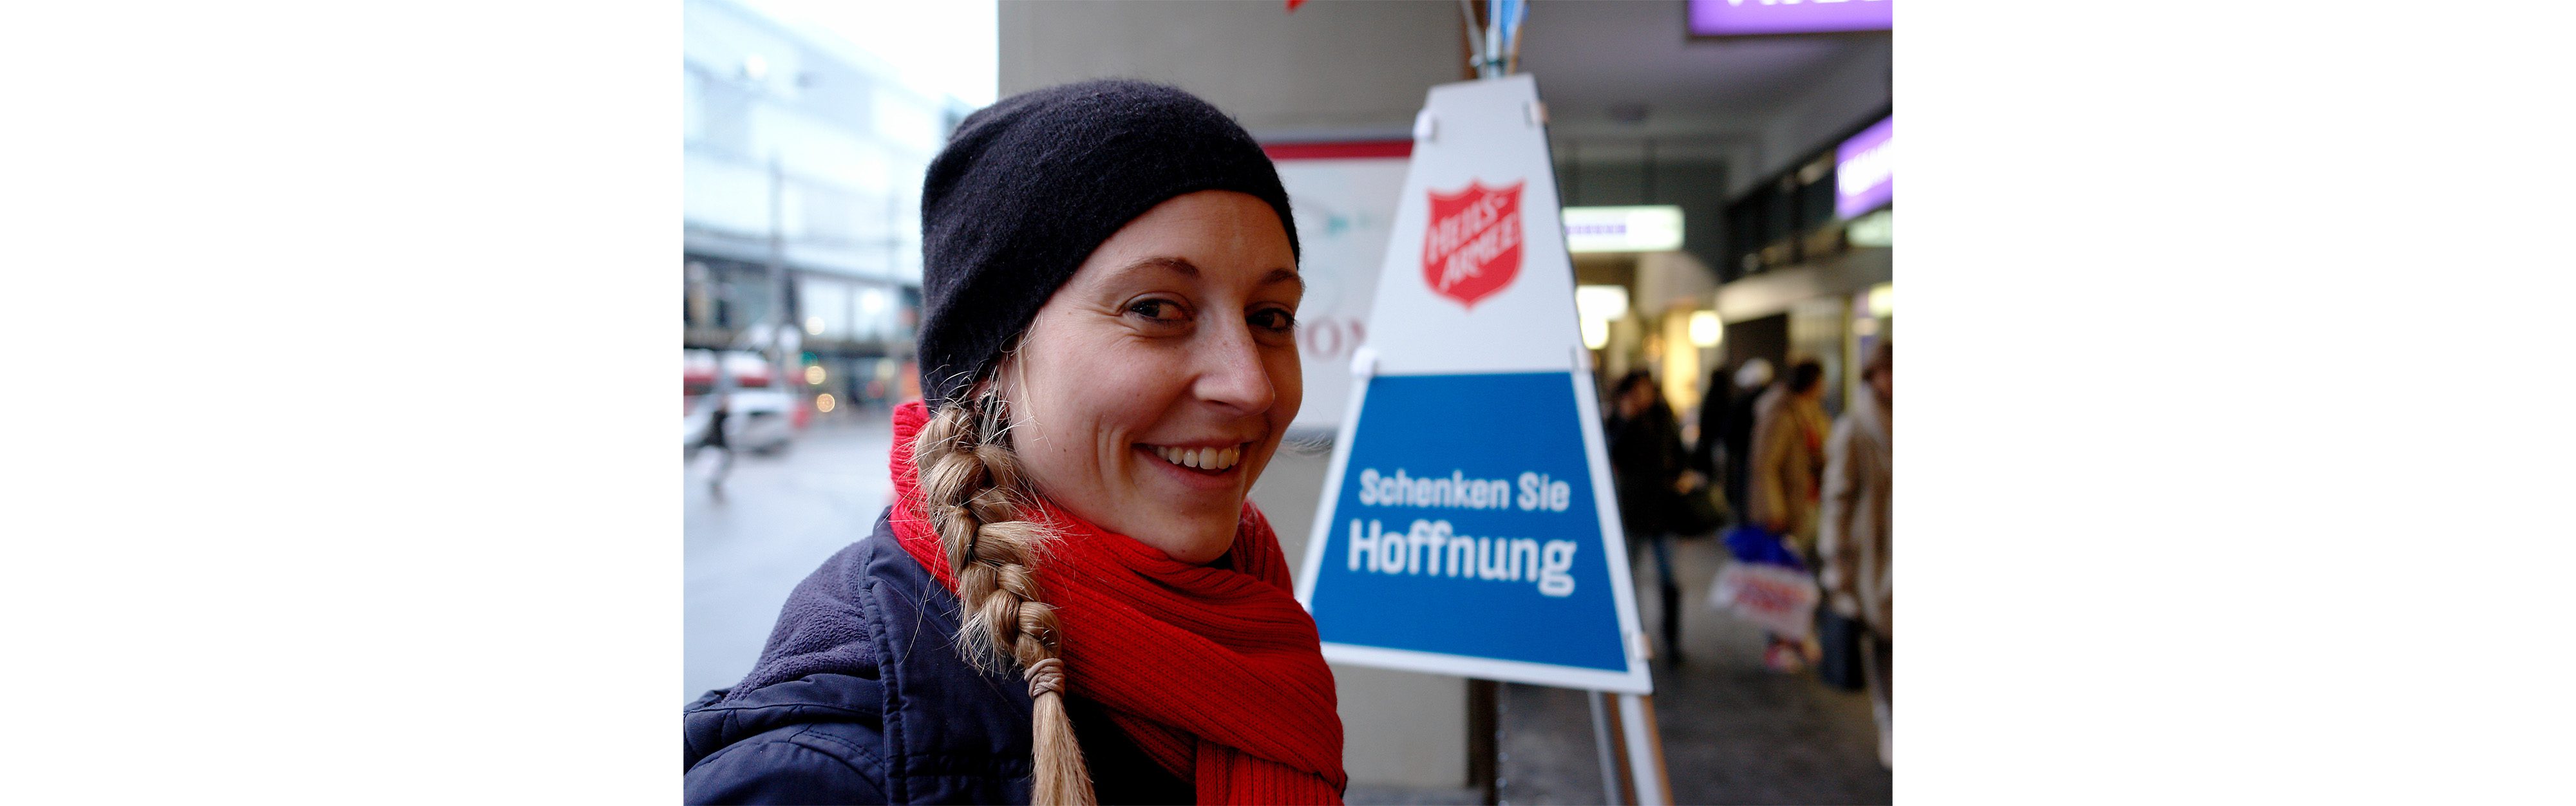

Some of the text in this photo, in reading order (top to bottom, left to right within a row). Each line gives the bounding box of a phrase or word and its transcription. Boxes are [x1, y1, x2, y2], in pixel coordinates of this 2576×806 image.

[1359, 469, 1571, 512] Schenken Sie
[1348, 519, 1577, 597] Hoffnung
